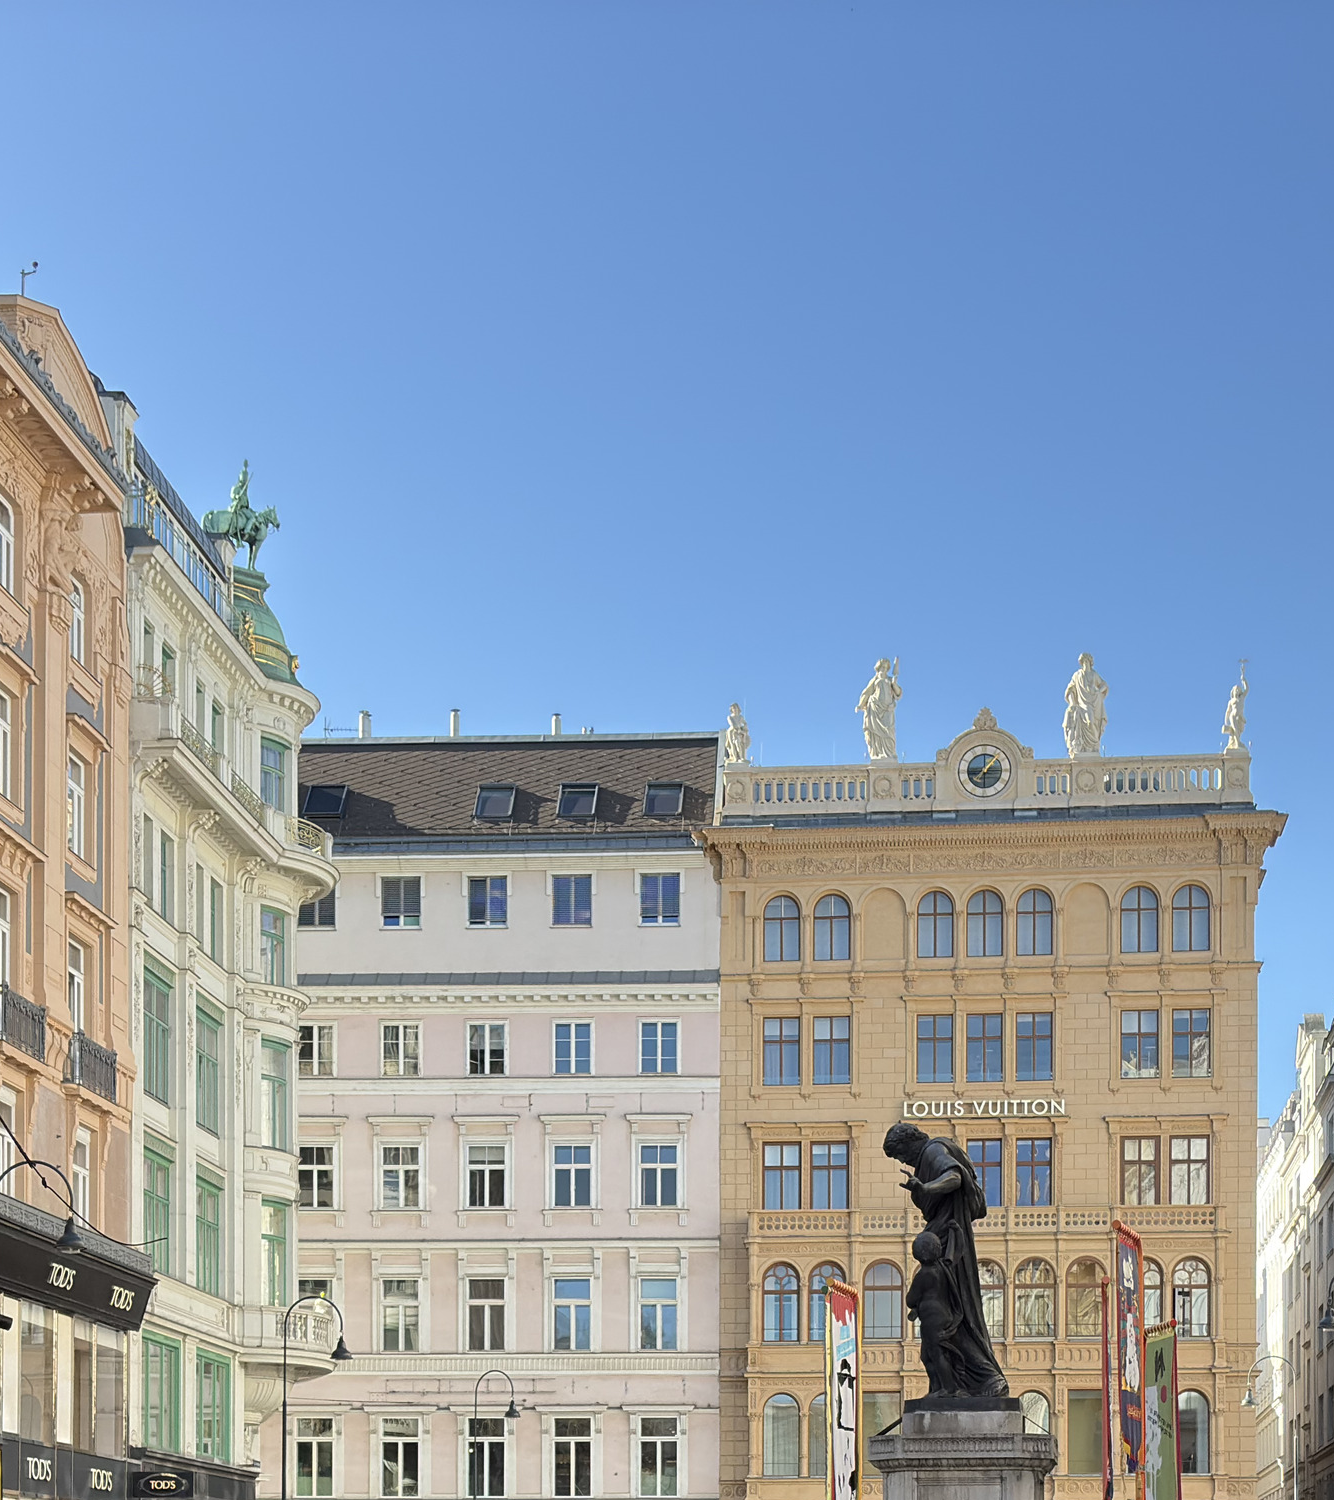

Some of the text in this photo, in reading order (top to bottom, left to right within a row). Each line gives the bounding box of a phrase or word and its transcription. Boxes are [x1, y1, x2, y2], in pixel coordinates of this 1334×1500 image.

[903, 1098, 1066, 1118] LOUIS VUITTON
[48, 1262, 76, 1291] TOD'S
[109, 1285, 135, 1312] TOD'S
[27, 1457, 52, 1482] TOD'S
[90, 1468, 113, 1492] TOD'S
[149, 1480, 176, 1490] TOD'S
